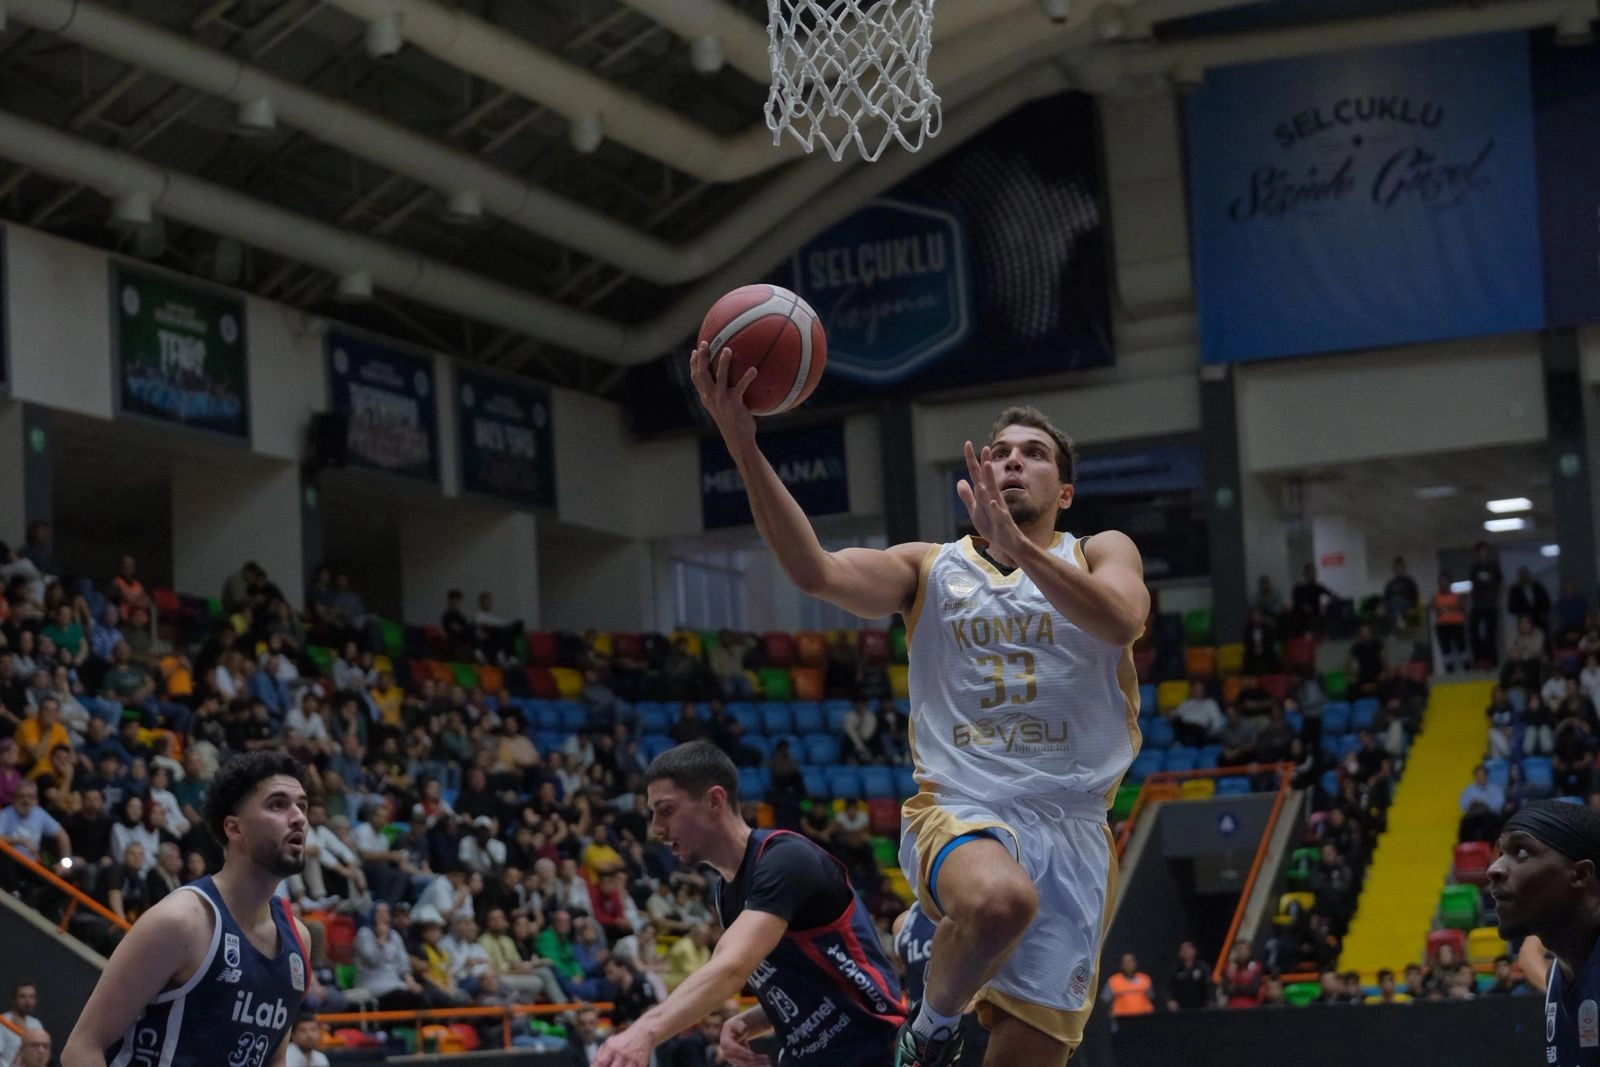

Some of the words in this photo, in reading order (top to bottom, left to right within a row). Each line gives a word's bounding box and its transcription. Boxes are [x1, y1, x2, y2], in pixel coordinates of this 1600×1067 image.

[703, 457, 830, 495] MEDANA
[952, 612, 1055, 650] KONYA
[976, 651, 1038, 709] 33
[826, 943, 887, 1013] emlakjet
[231, 989, 288, 1031] iLab
[228, 1031, 270, 1067] 33
